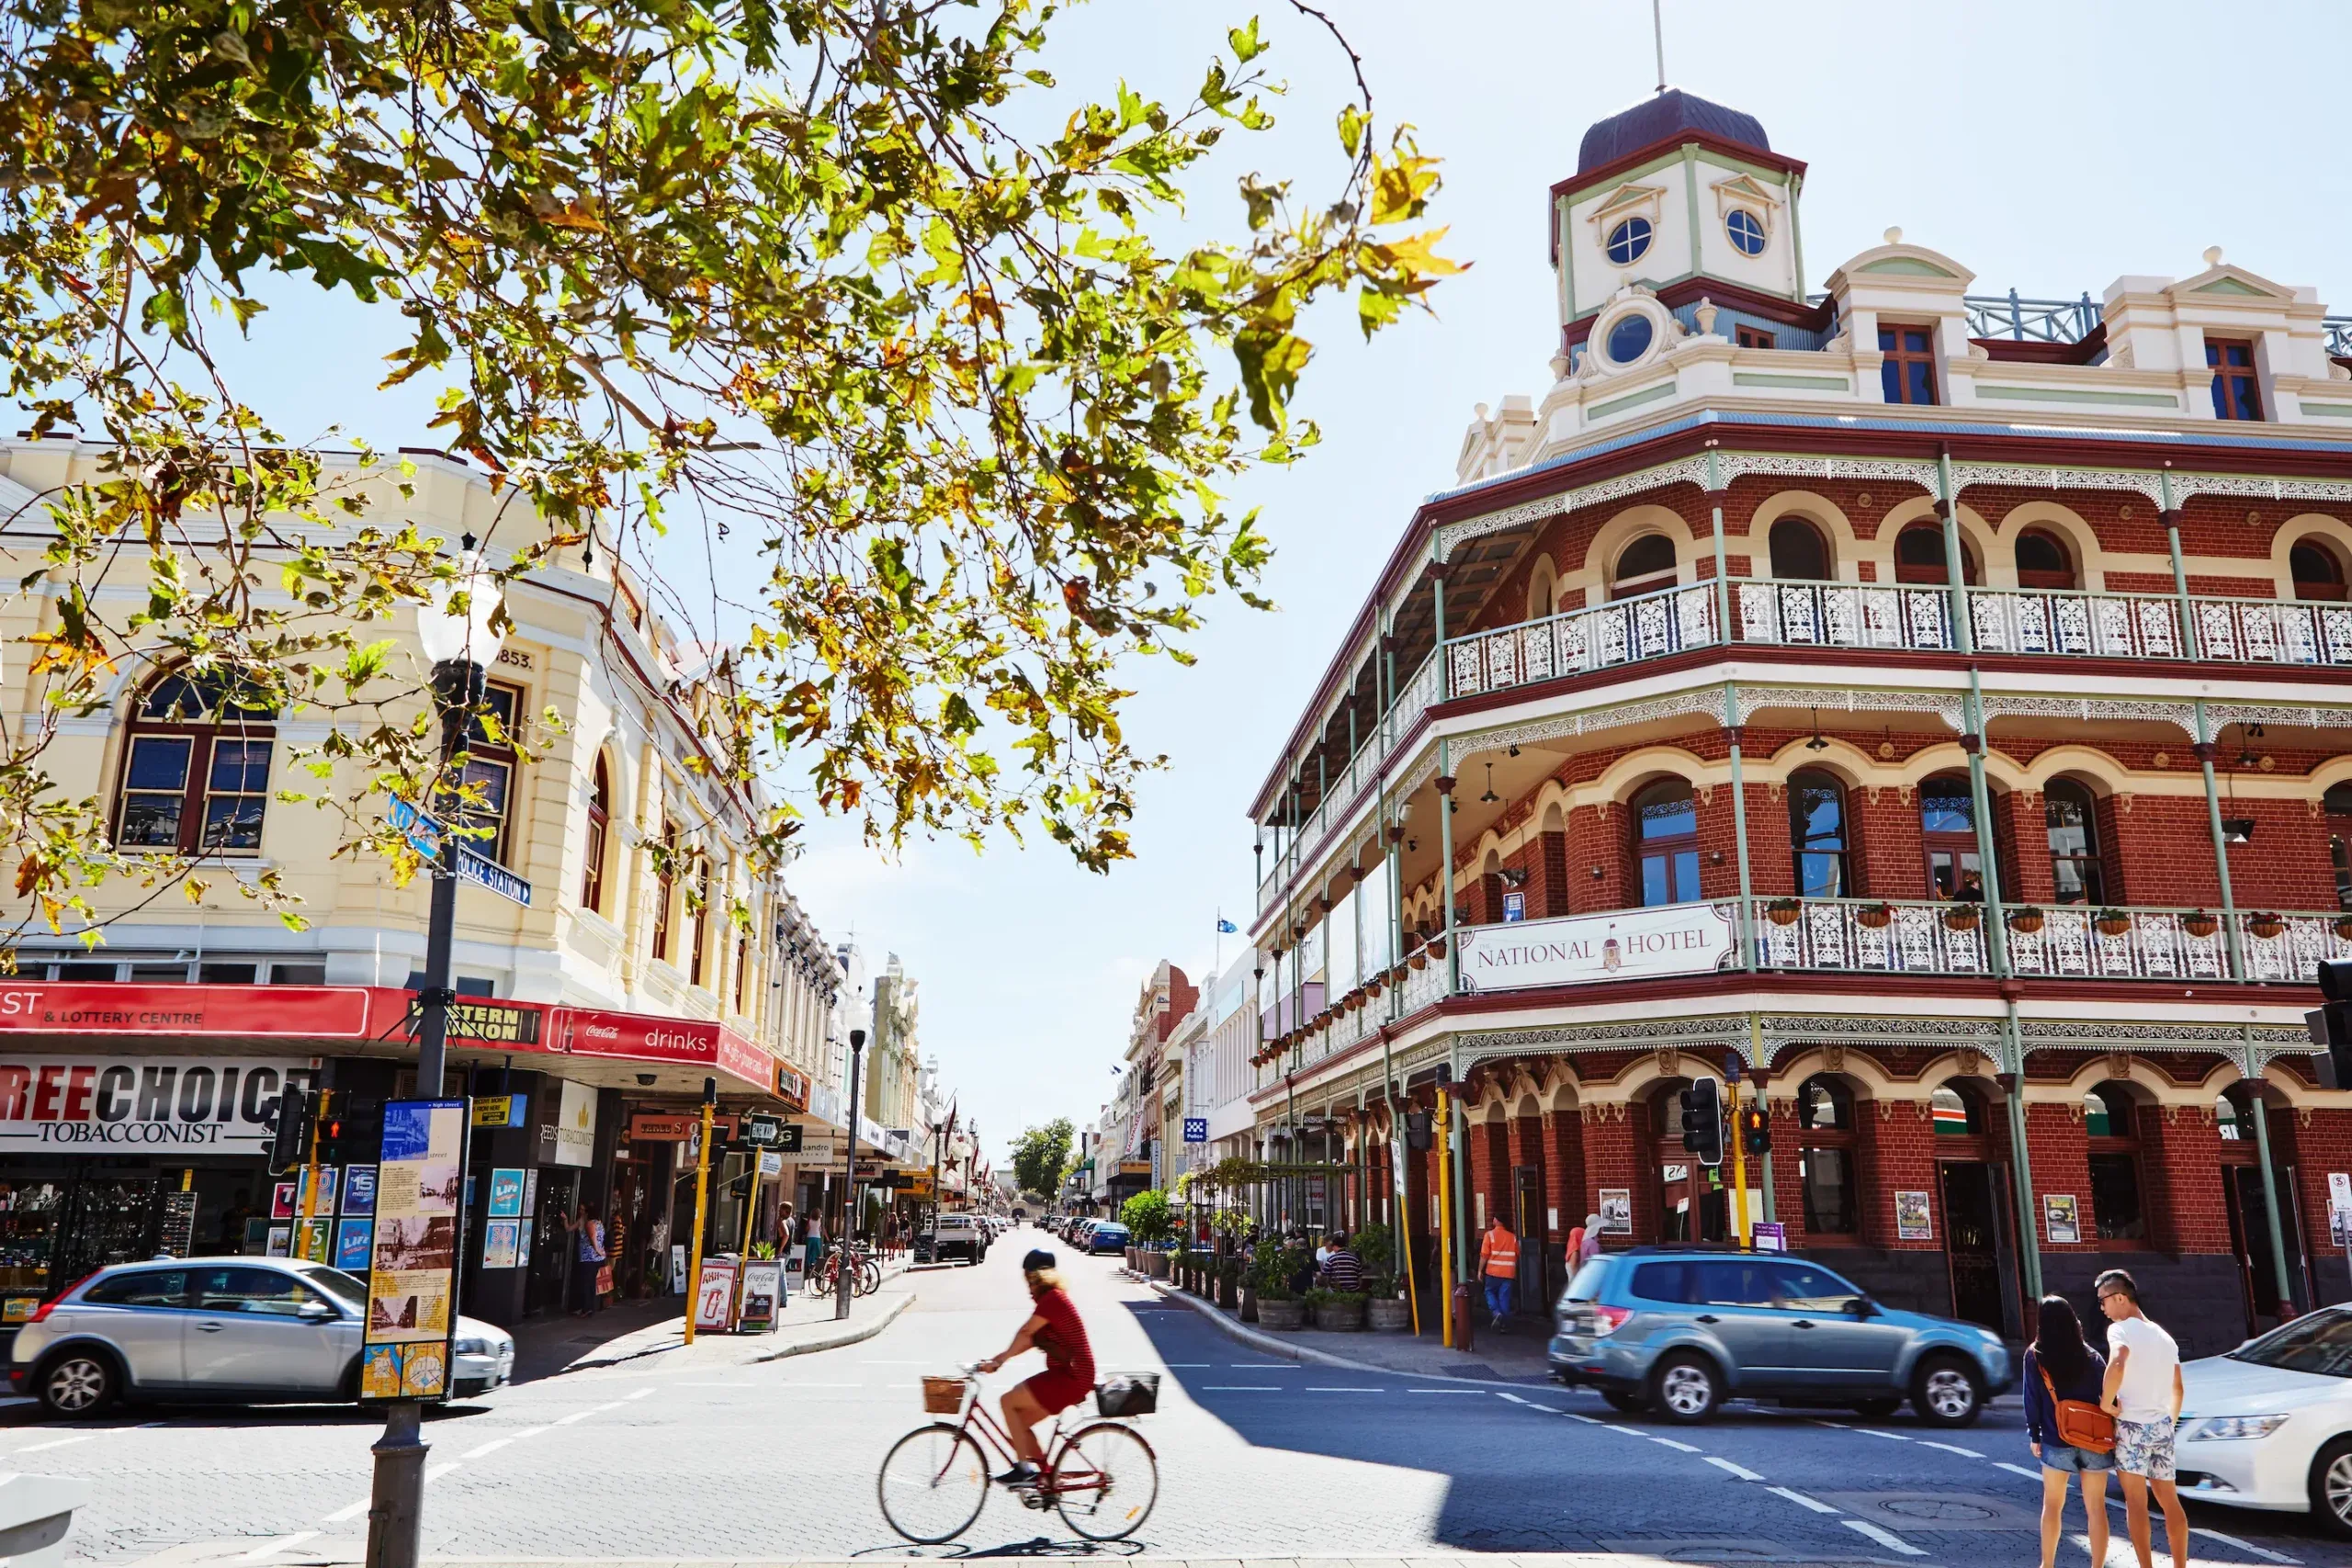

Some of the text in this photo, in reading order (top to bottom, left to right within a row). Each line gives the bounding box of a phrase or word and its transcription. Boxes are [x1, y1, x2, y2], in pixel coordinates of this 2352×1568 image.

[488, 866, 521, 900] STATION
[1477, 929, 1712, 968] NATIONAL HOTEL
[0, 991, 203, 1024] ST & LOTTERY CENTRE
[412, 1000, 519, 1025] WSTERN
[644, 1028, 707, 1052] drinks
[38, 1122, 223, 1144] TOBACCONIST
[560, 1127, 594, 1146] TOBACCONIST
[350, 1176, 373, 1191] $15
[496, 1184, 518, 1196] LIFE
[344, 1235, 369, 1249] LIFE
[756, 1281, 768, 1291] life
